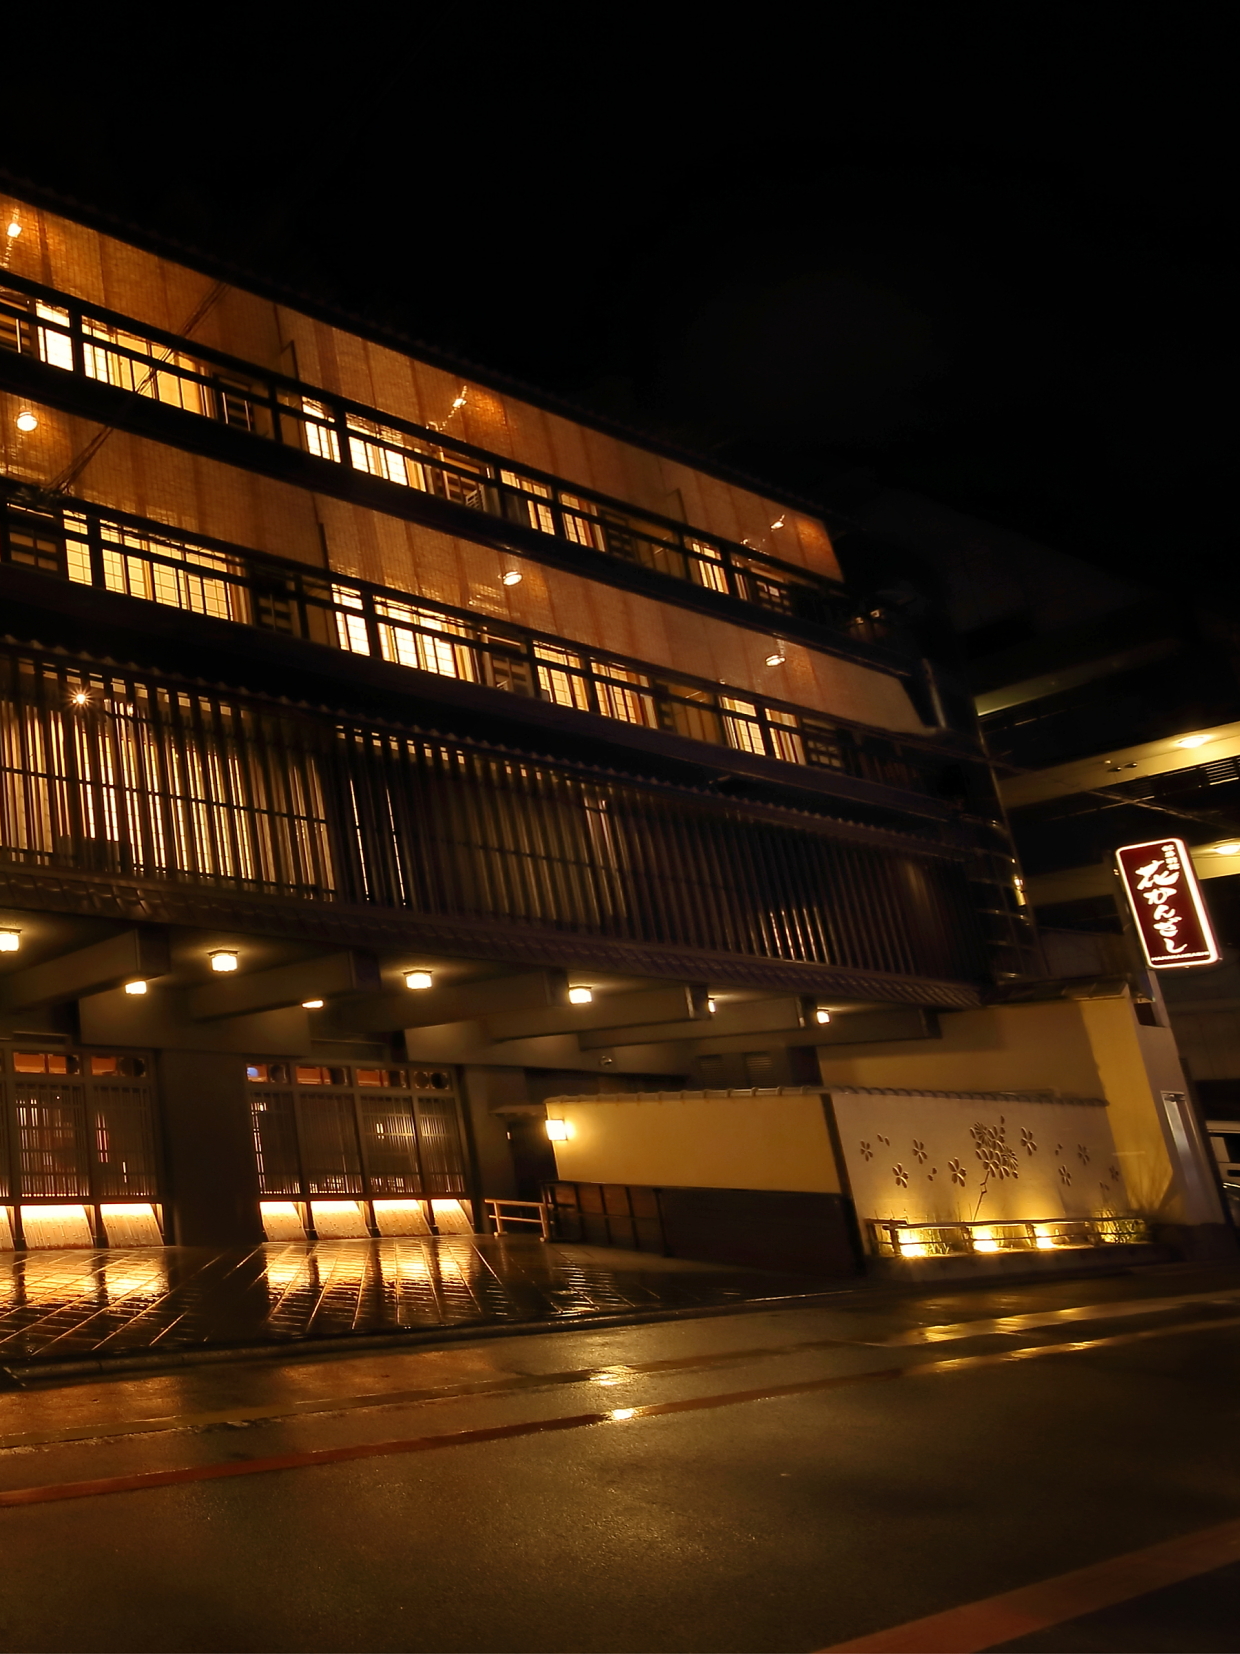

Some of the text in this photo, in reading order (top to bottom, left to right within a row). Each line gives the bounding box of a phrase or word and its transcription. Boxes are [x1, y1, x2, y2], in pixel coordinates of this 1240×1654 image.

[1135, 860, 1188, 953] 花かんざし
